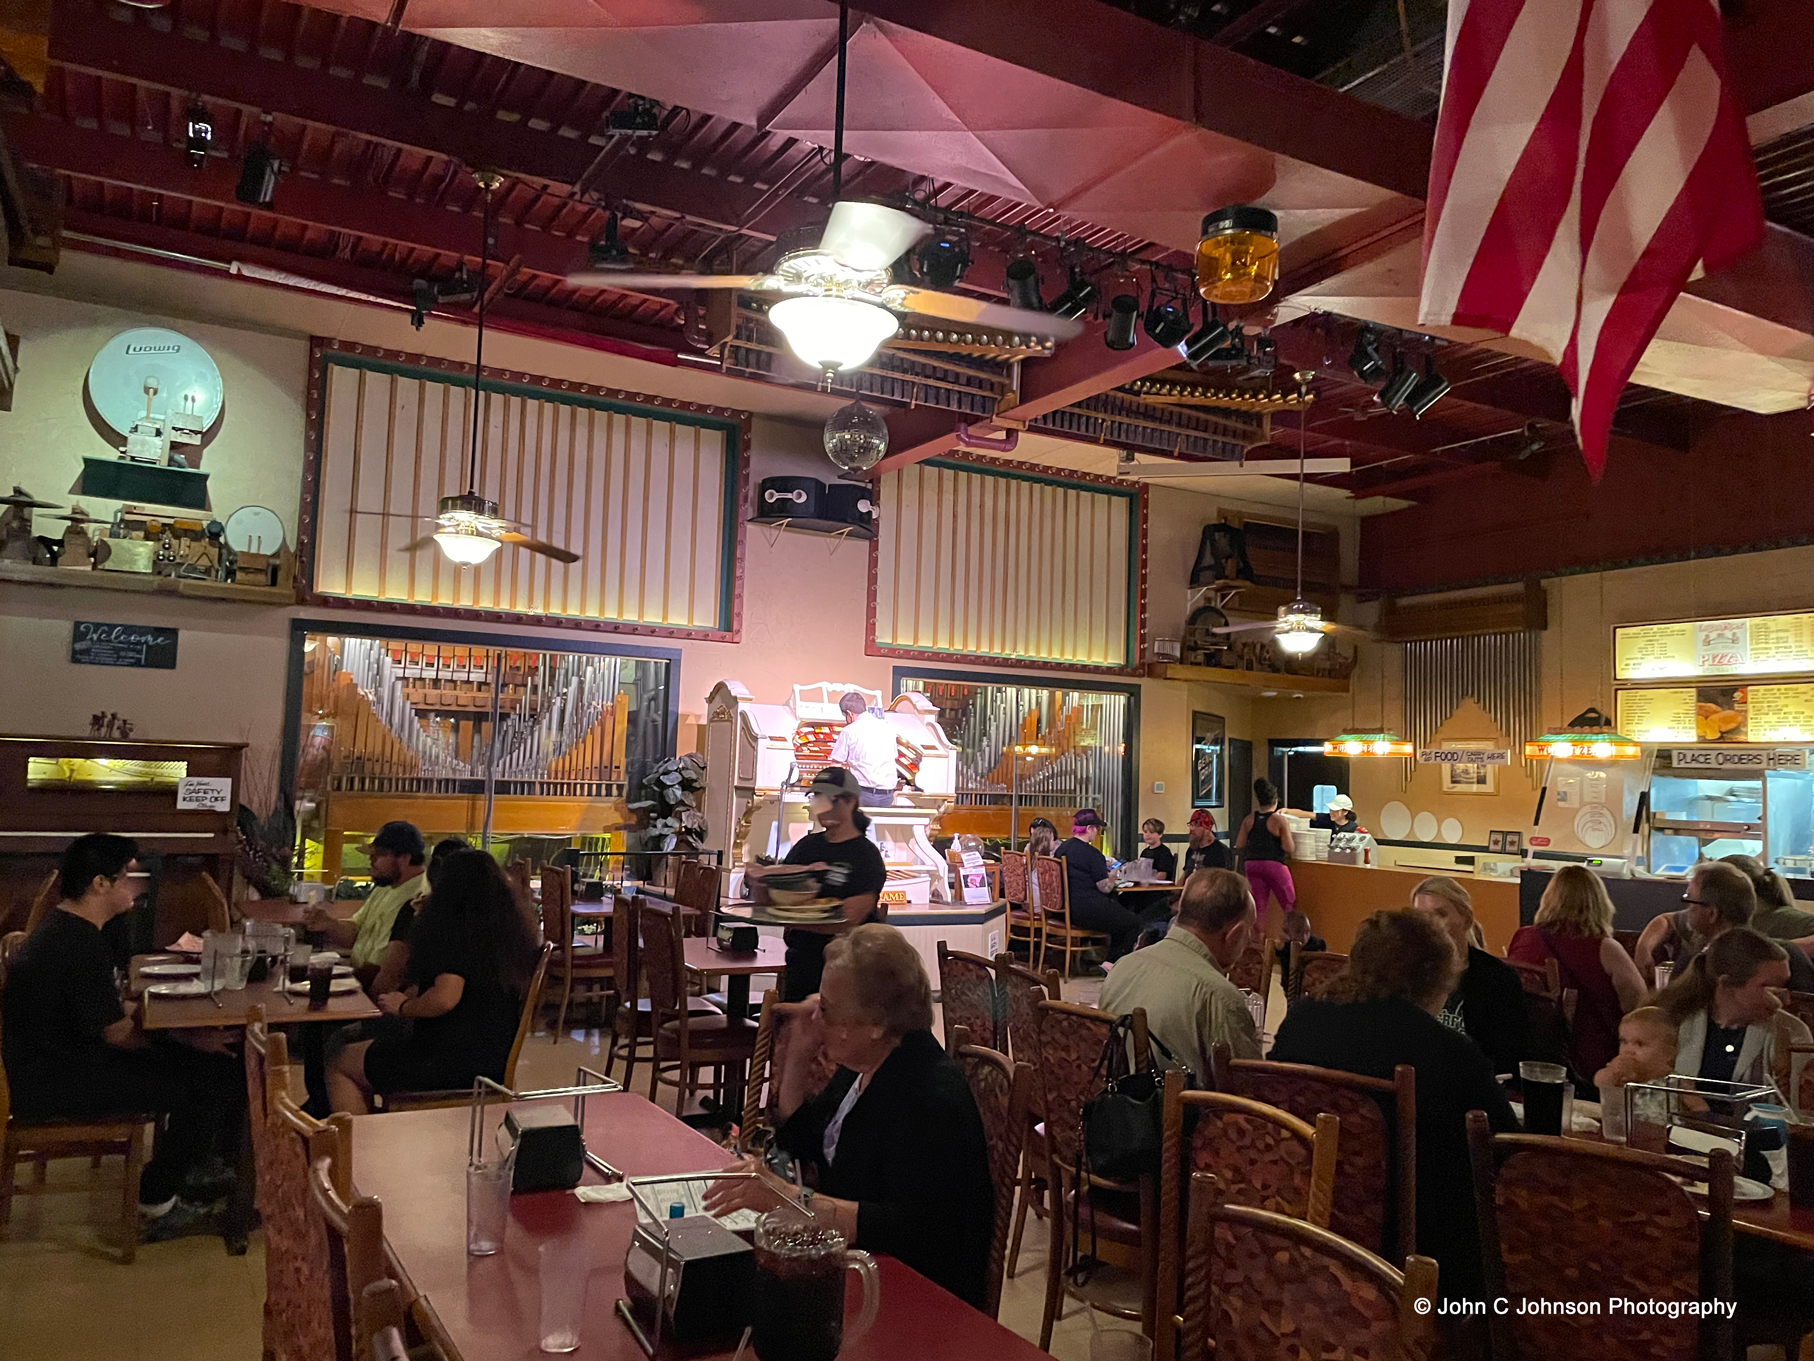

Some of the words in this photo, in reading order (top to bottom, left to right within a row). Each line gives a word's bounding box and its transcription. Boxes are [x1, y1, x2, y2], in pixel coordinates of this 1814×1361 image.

[80, 623, 170, 645] Welcome
[1486, 752, 1506, 760] HERE
[1677, 752, 1712, 765] PLACE
[1715, 752, 1763, 766] ORDERS
[1766, 752, 1801, 767] HERE
[209, 795, 227, 803] OFF
